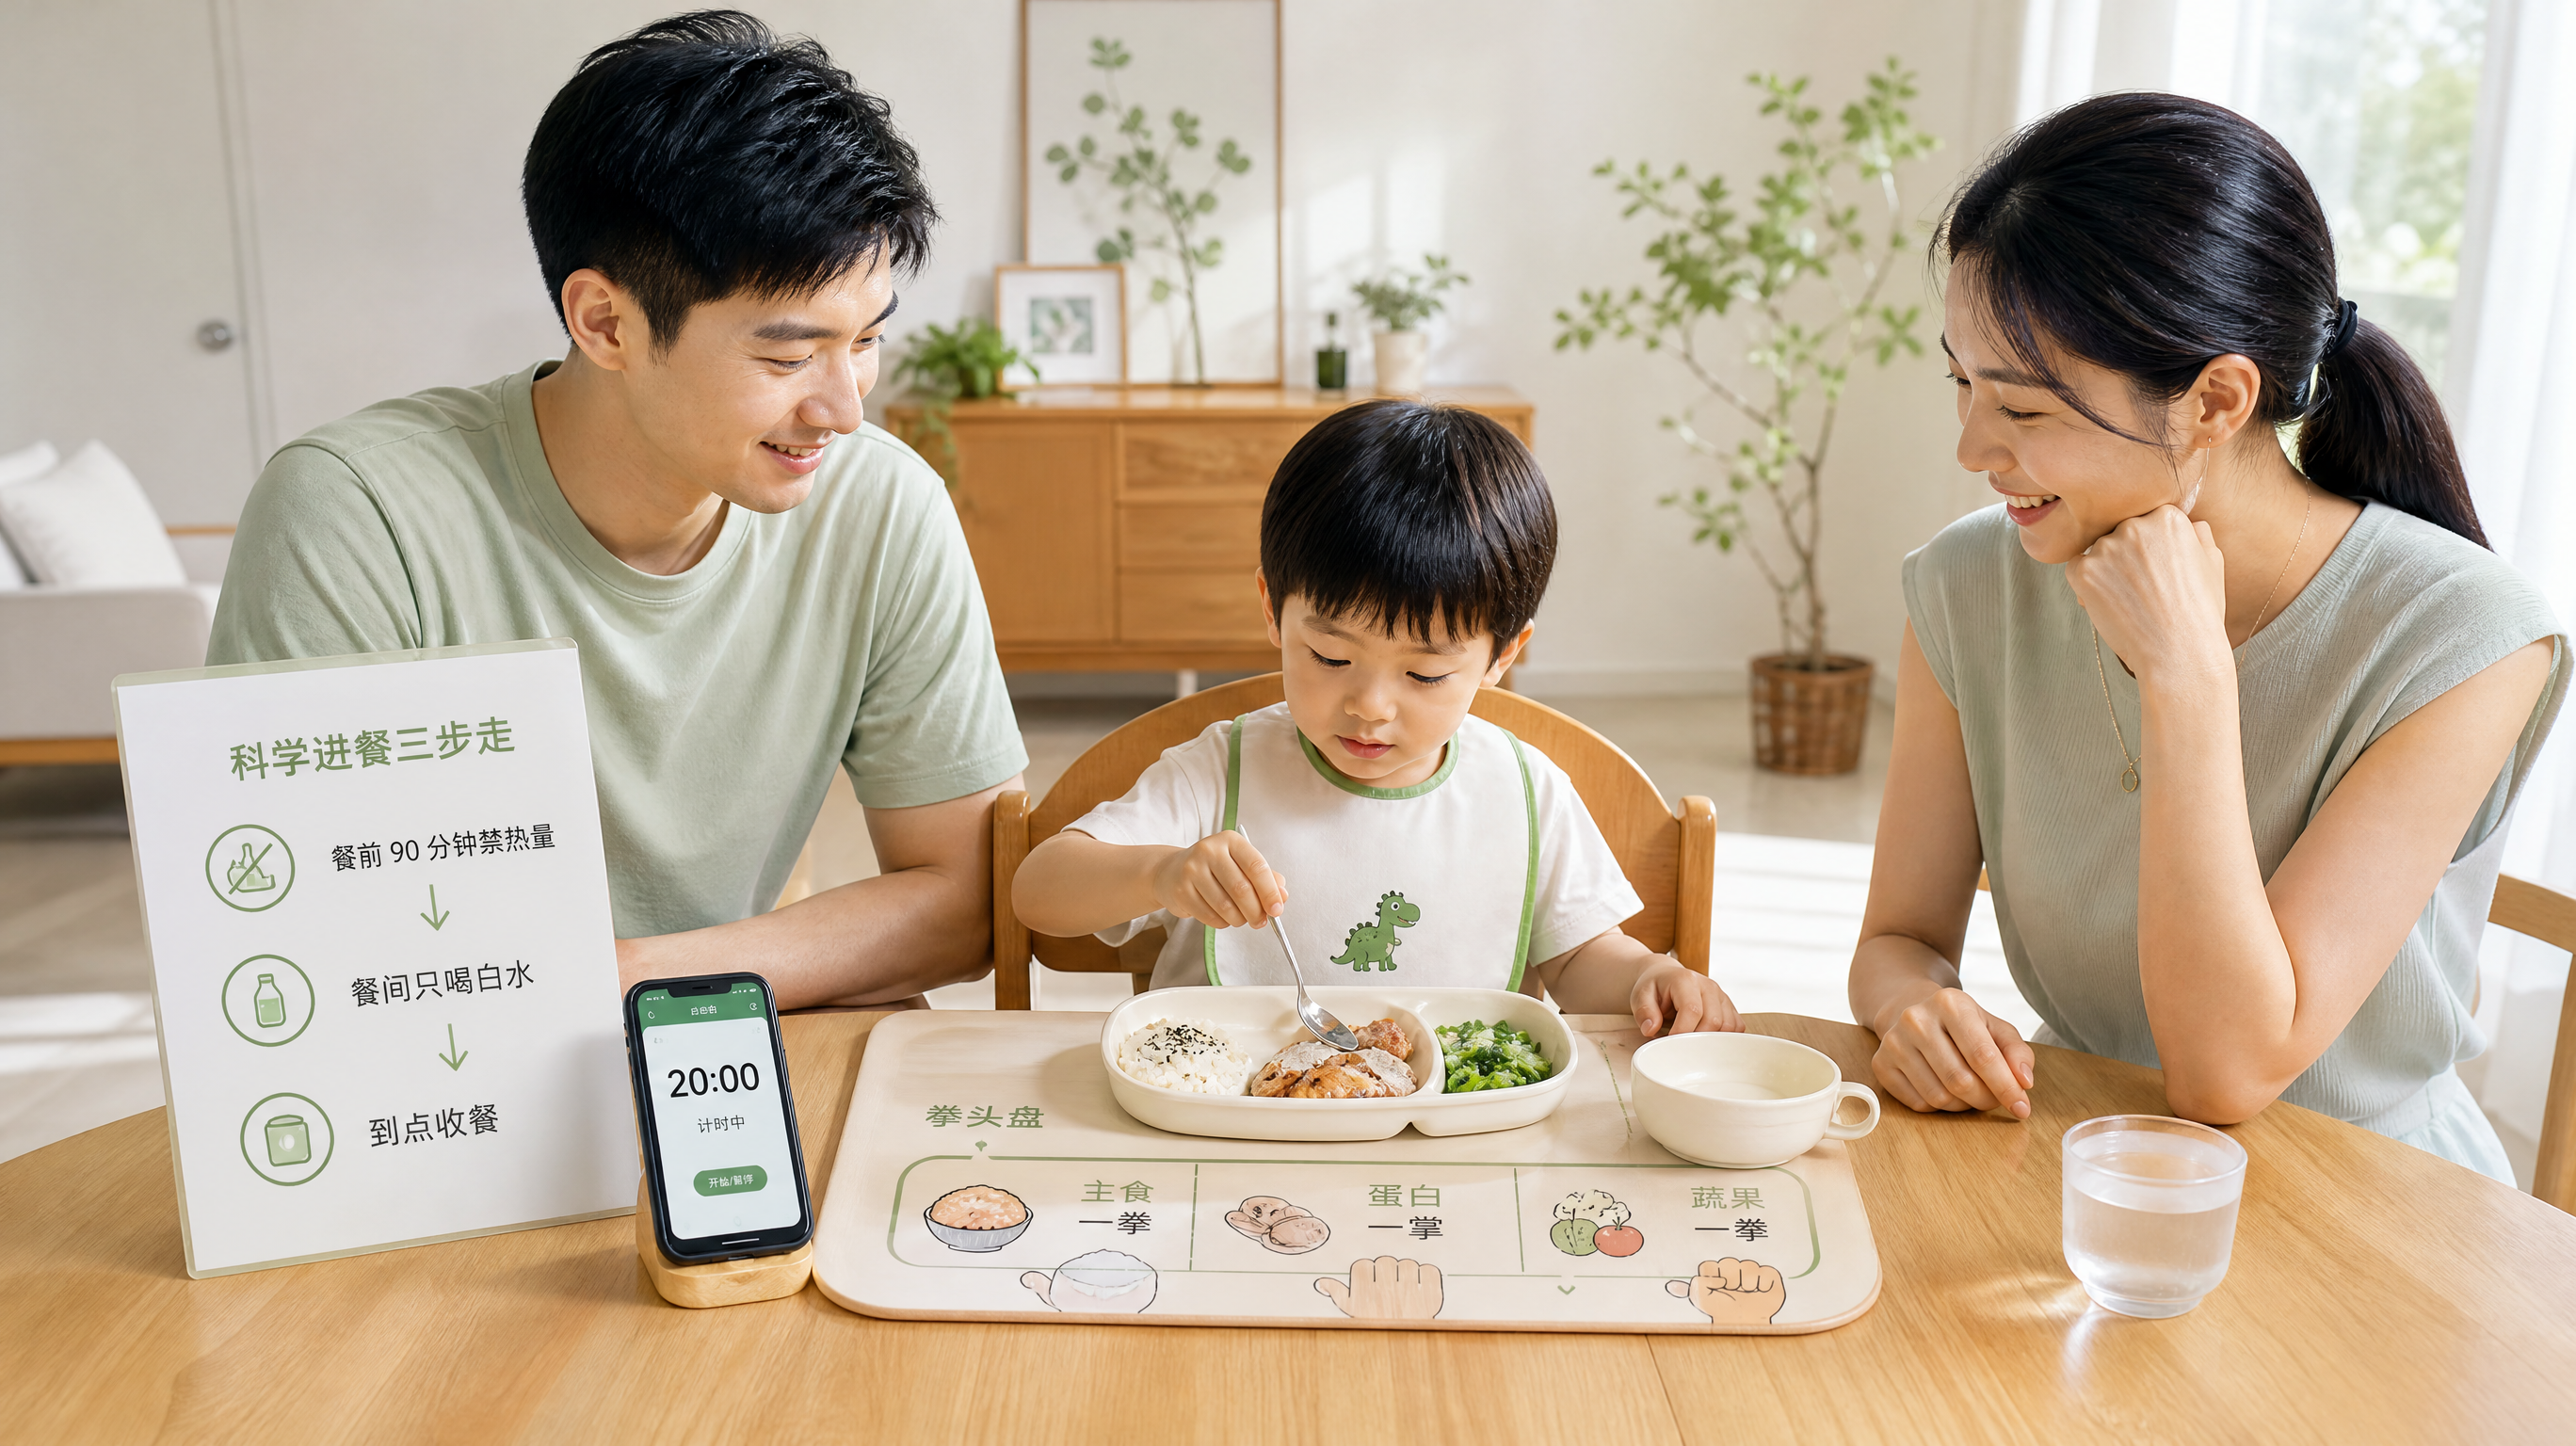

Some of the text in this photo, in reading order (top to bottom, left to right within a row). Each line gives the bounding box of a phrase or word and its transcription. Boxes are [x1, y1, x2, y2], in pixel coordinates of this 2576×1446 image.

[230, 715, 516, 781] 科学进餐三步走
[331, 823, 555, 872] 餐前 90 分钟禁热量
[351, 959, 535, 1007] 餐间只喝白水
[668, 1062, 760, 1099] 20:00
[368, 1103, 499, 1148] 到点收餐
[697, 1115, 745, 1133] 计时中
[926, 1104, 1045, 1129] 拳头盘
[1080, 1179, 1154, 1203] 主食
[1368, 1183, 1441, 1208] 蛋白
[1690, 1185, 1765, 1210] 蔬果
[1078, 1211, 1152, 1235] 一拳
[1367, 1215, 1443, 1241] 一掌
[1694, 1218, 1769, 1242] 一拳
